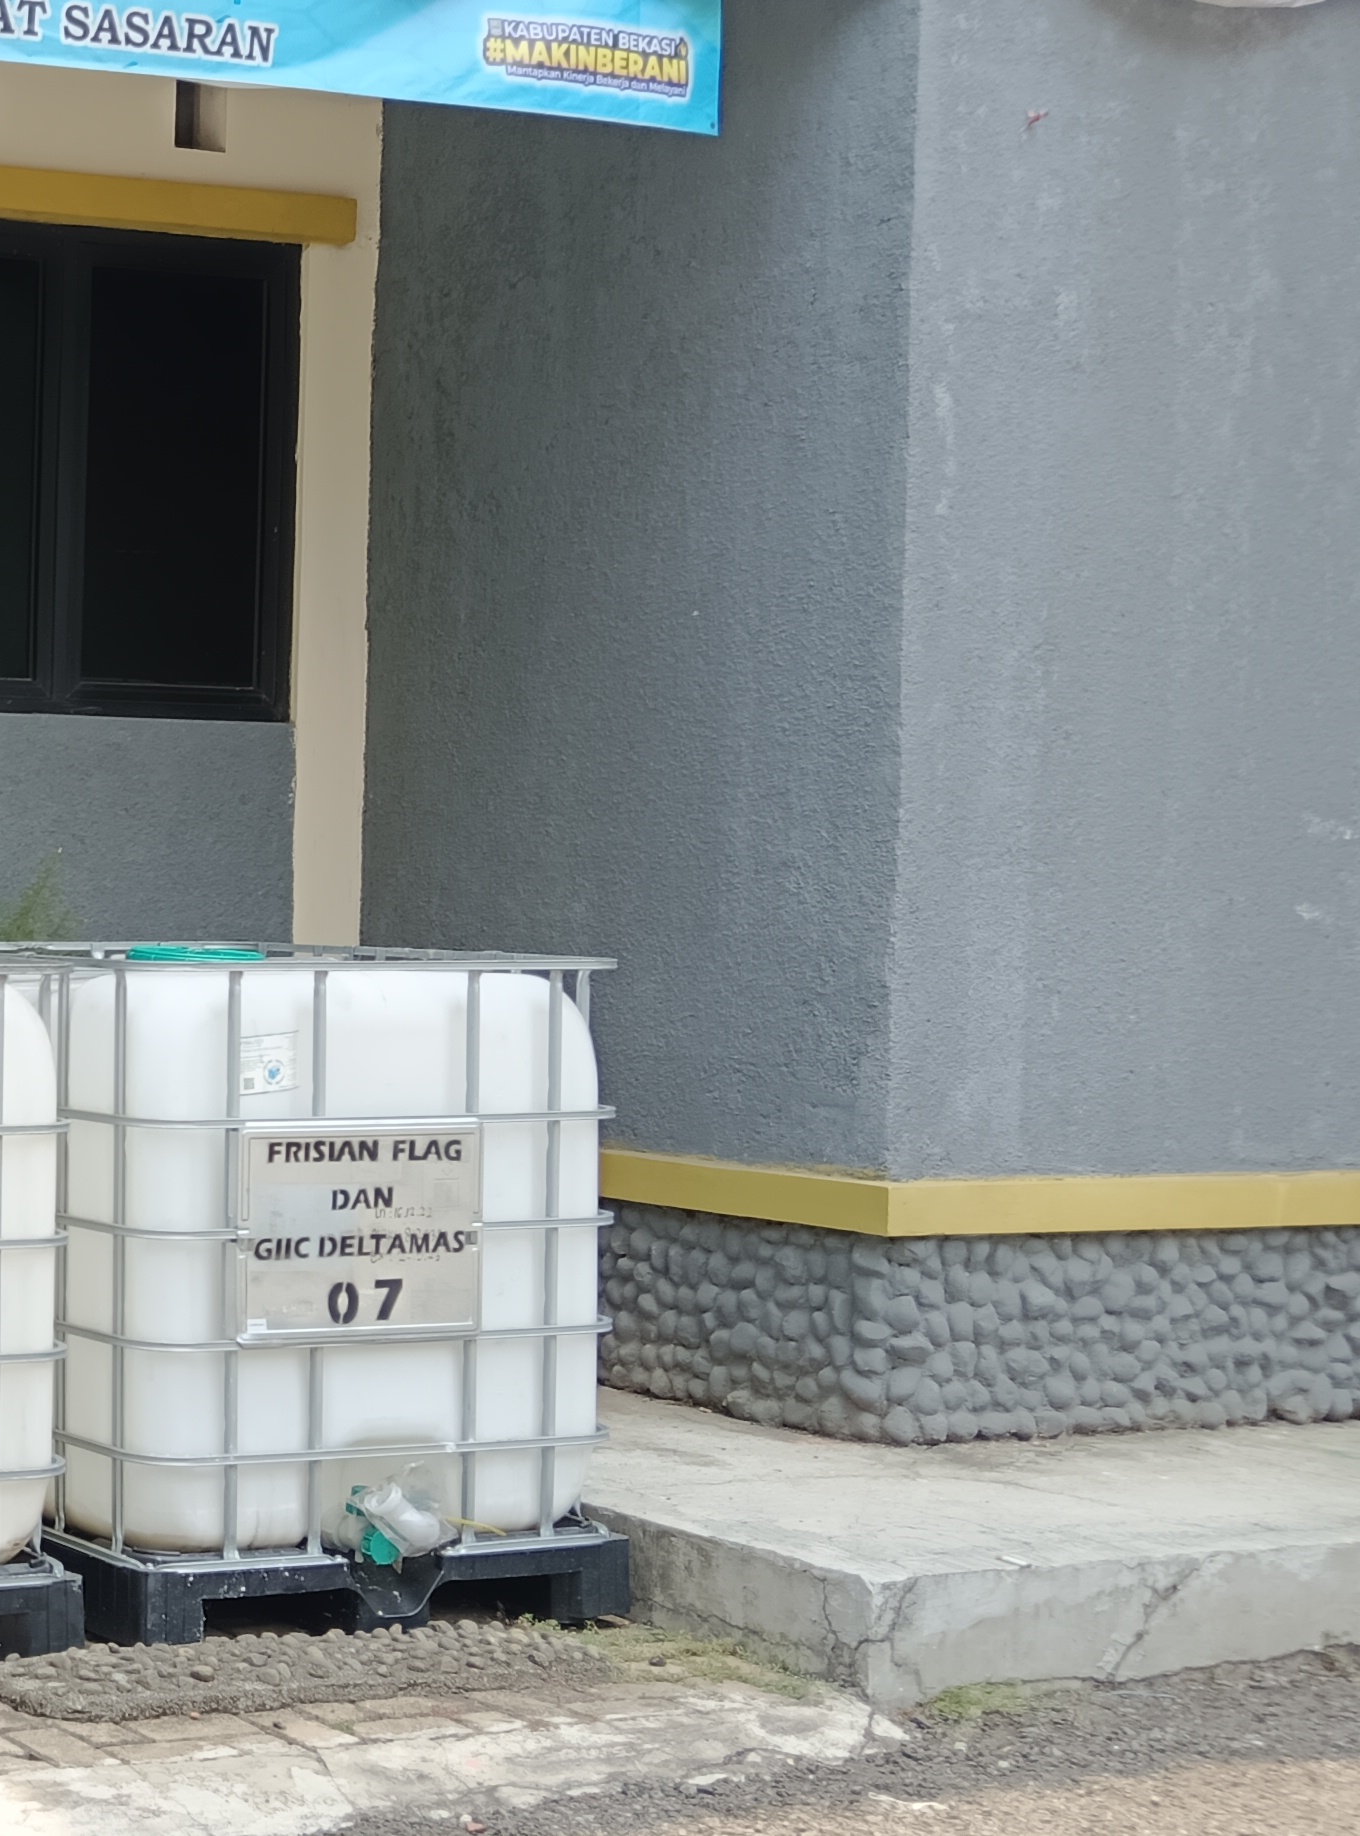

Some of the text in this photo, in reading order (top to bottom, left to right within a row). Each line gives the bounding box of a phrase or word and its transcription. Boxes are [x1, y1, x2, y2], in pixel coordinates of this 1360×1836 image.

[63, 4, 276, 63] SASARAN
[504, 21, 677, 56] KABUPATEN BEKASI
[486, 37, 688, 85] #MAKINBERANI
[507, 65, 561, 81] Mantapkan
[563, 71, 595, 86] Kinerja
[597, 75, 630, 90] Bekerja
[649, 81, 687, 97] Melayani
[267, 1138, 462, 1163] FRISIAN FLAG
[331, 1186, 394, 1211] DAN
[254, 1237, 311, 1261] GIIC
[318, 1230, 466, 1257] DELTAMAS
